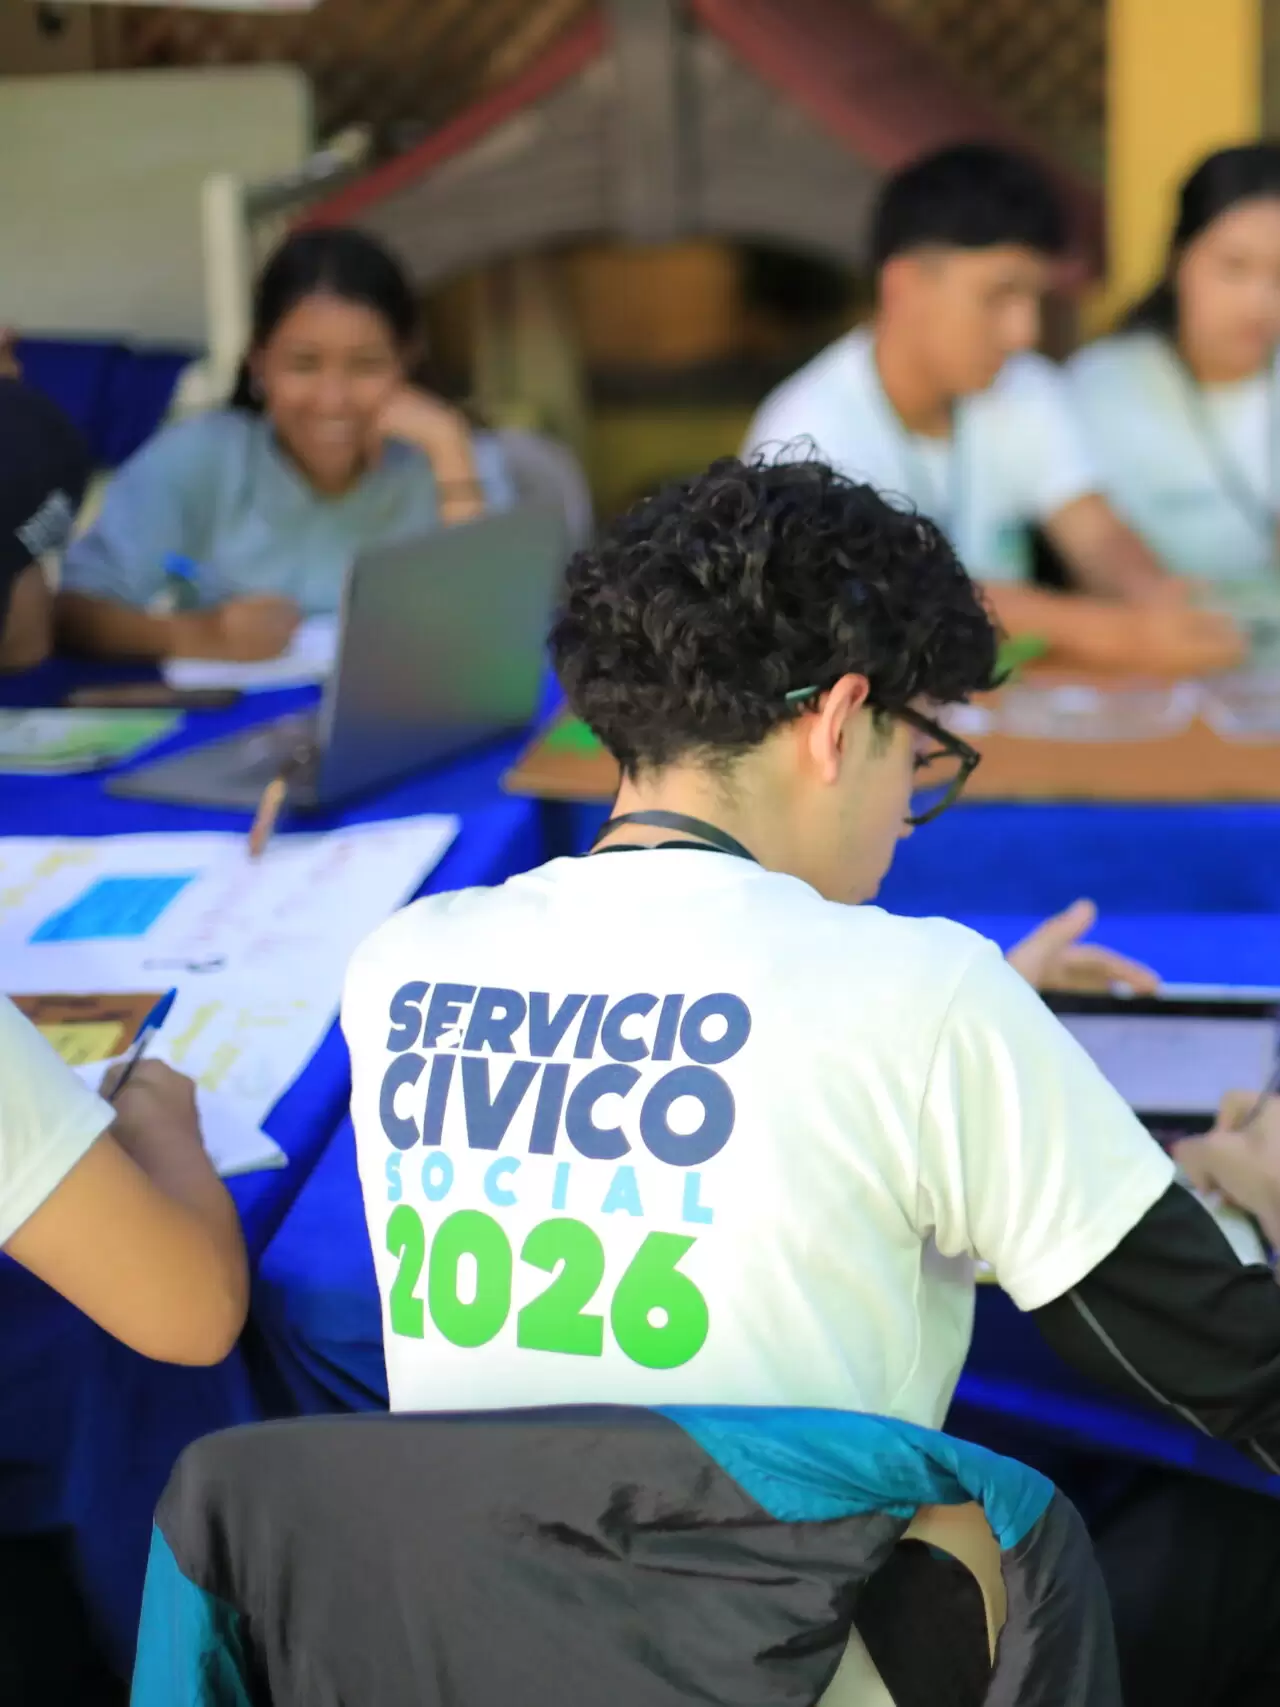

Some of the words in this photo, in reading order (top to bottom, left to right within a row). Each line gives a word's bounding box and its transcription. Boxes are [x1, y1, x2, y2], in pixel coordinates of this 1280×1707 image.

[386, 980, 752, 1065] SERVICIO
[385, 1151, 714, 1225] SOCIAL
[386, 1203, 710, 1370] 2026
